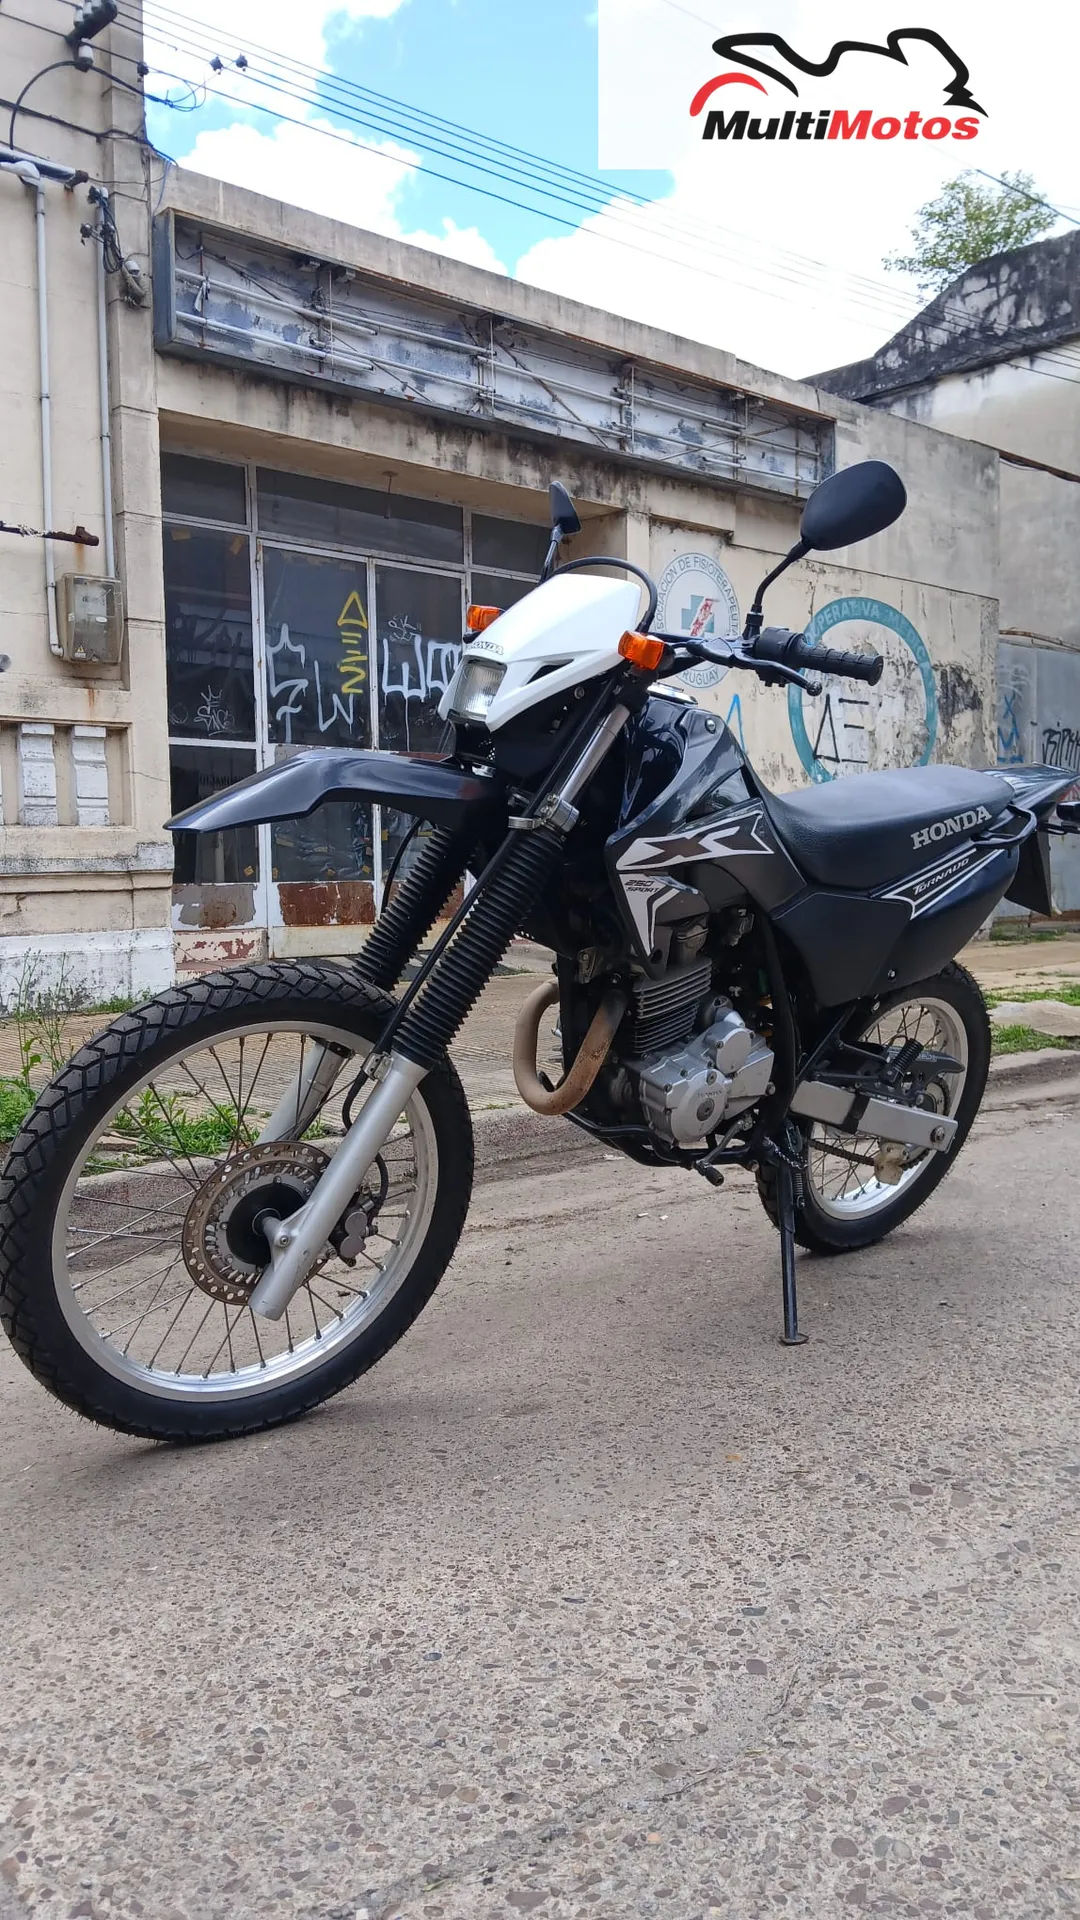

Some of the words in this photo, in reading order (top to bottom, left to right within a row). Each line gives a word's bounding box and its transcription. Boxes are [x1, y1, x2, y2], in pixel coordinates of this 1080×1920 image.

[655, 565, 677, 633] SOCIACION
[678, 556, 691, 572] DE
[682, 671, 720, 686] RUGUAY
[910, 805, 992, 850] HONDA
[912, 858, 969, 895] TORNADO
